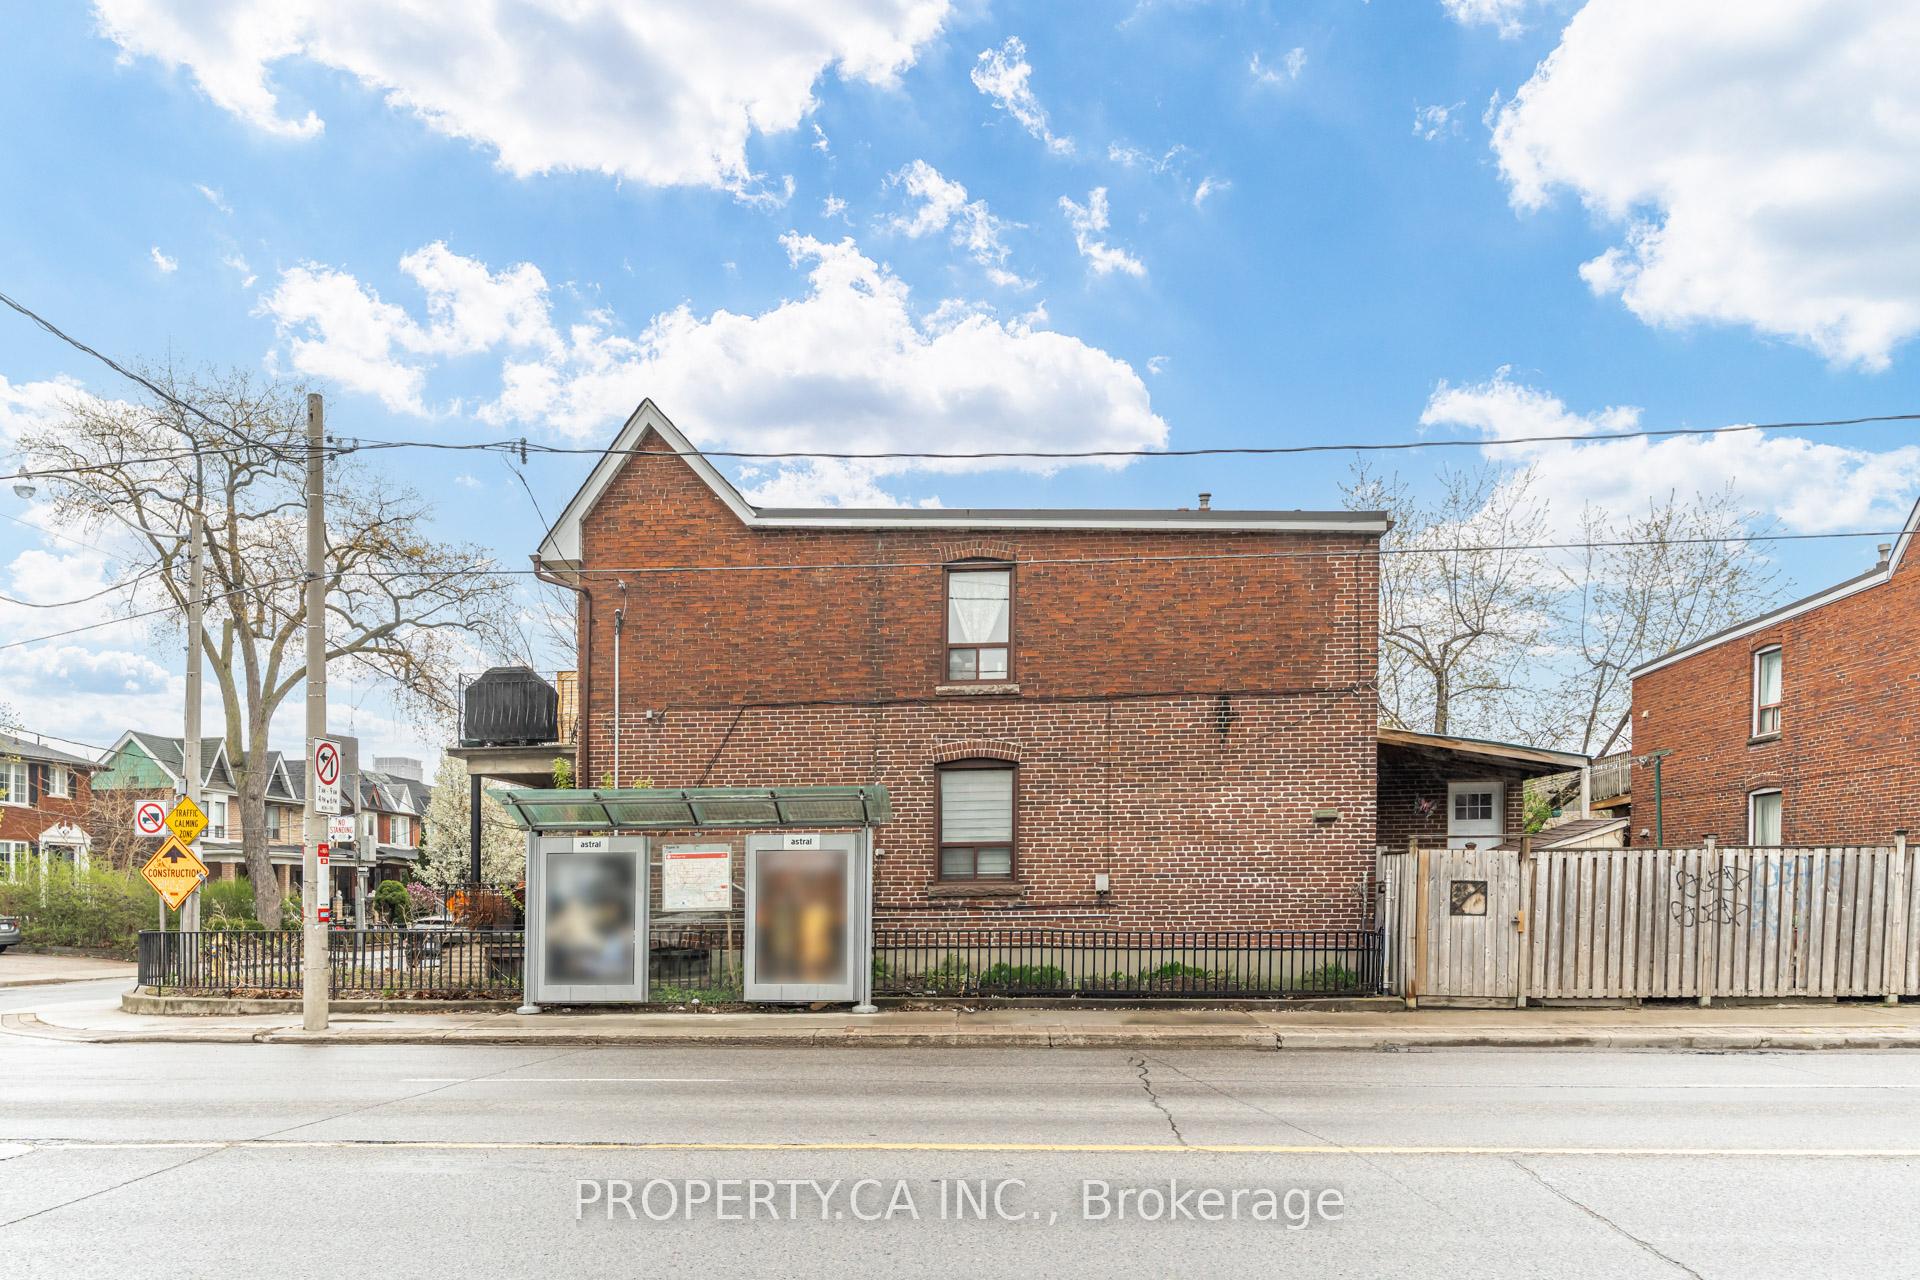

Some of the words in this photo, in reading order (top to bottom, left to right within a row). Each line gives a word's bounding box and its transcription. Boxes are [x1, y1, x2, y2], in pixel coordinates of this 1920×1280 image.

[175, 809, 198, 817] TRAFFIC
[174, 819, 199, 827] CALMING
[338, 818, 346, 826] NO
[179, 830, 193, 838] ZONE
[329, 826, 353, 834] STANDING
